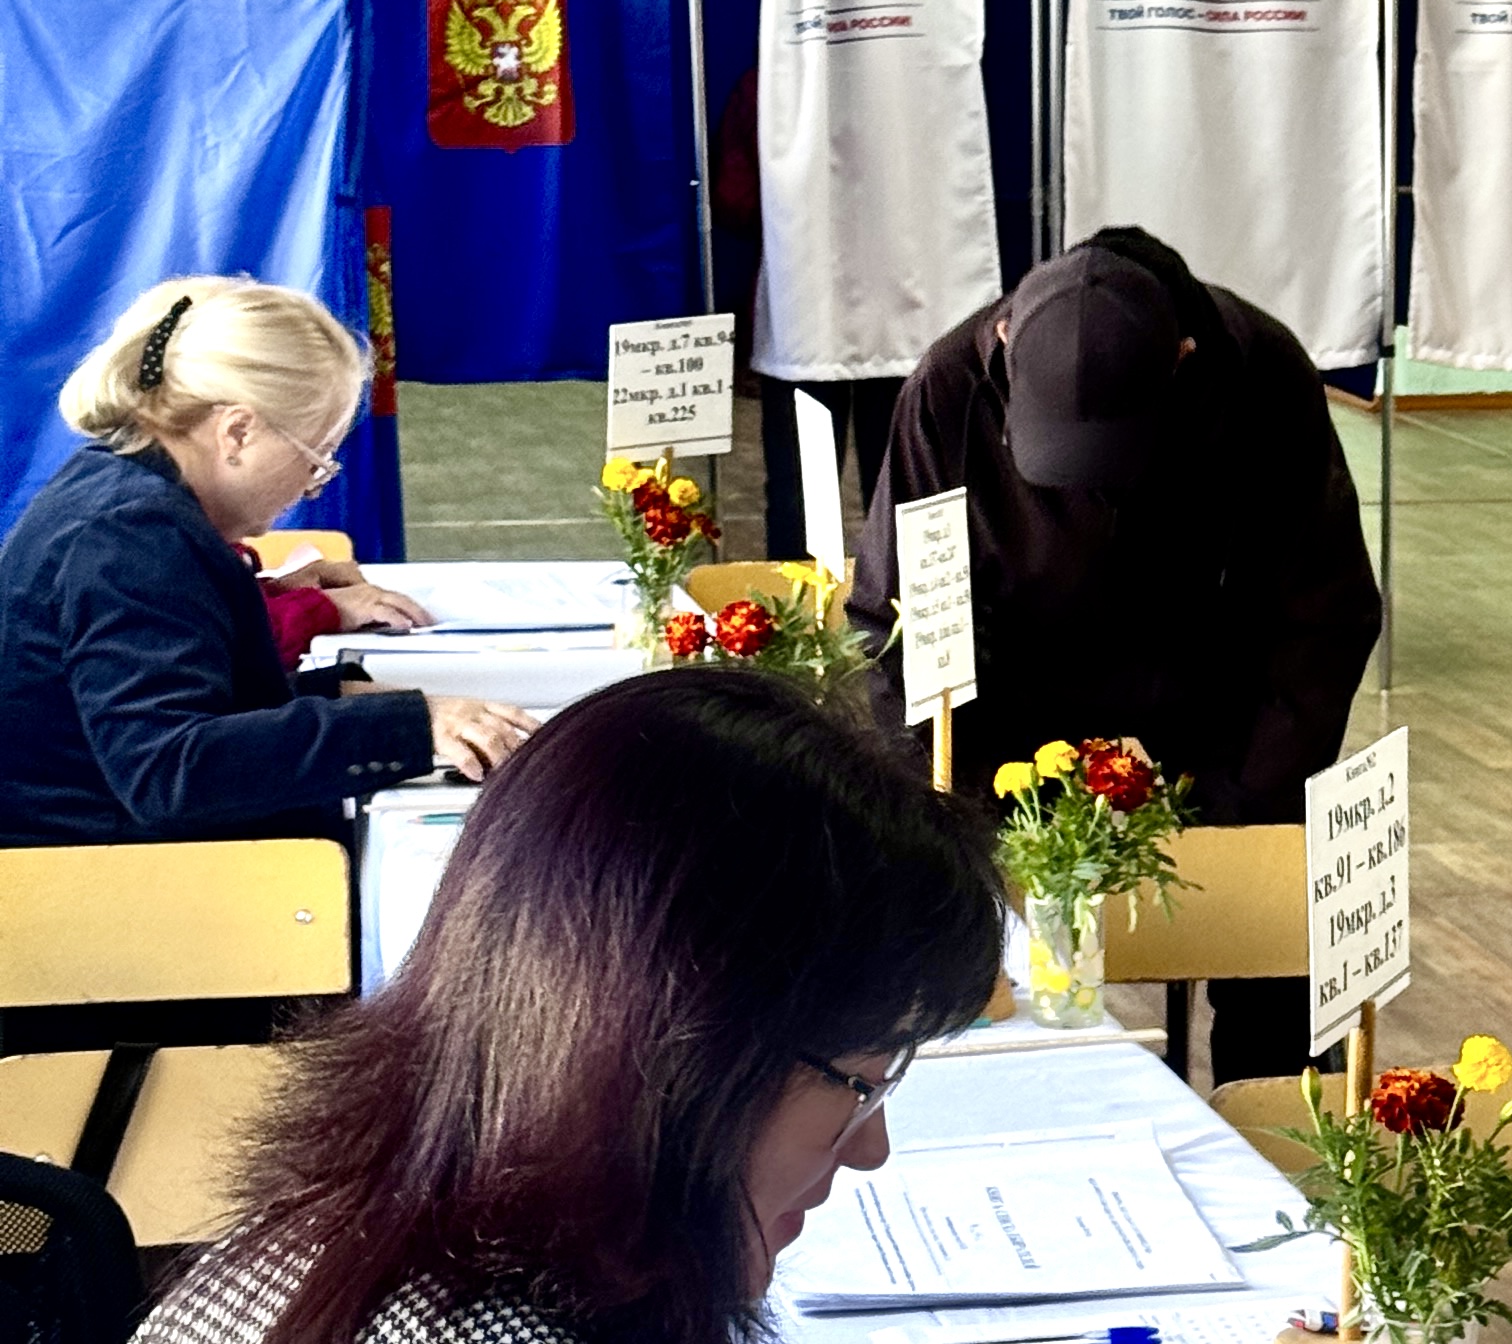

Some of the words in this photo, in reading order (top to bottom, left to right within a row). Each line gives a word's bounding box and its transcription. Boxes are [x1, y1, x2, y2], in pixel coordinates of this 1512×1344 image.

[1108, 4, 1144, 21] ТВОЙ
[1147, 6, 1196, 20] ГОЛОС
[1470, 10, 1508, 25] ТВОЙ
[613, 387, 663, 405] 22мкр.
[692, 378, 723, 396] кв.1
[647, 404, 697, 424] кв.225
[1327, 796, 1376, 842] 19мкр.
[1377, 772, 1395, 814] д.2
[1314, 851, 1352, 904] кв.91
[1328, 894, 1377, 948] 19мкр.
[1318, 959, 1348, 1007] кв.1
